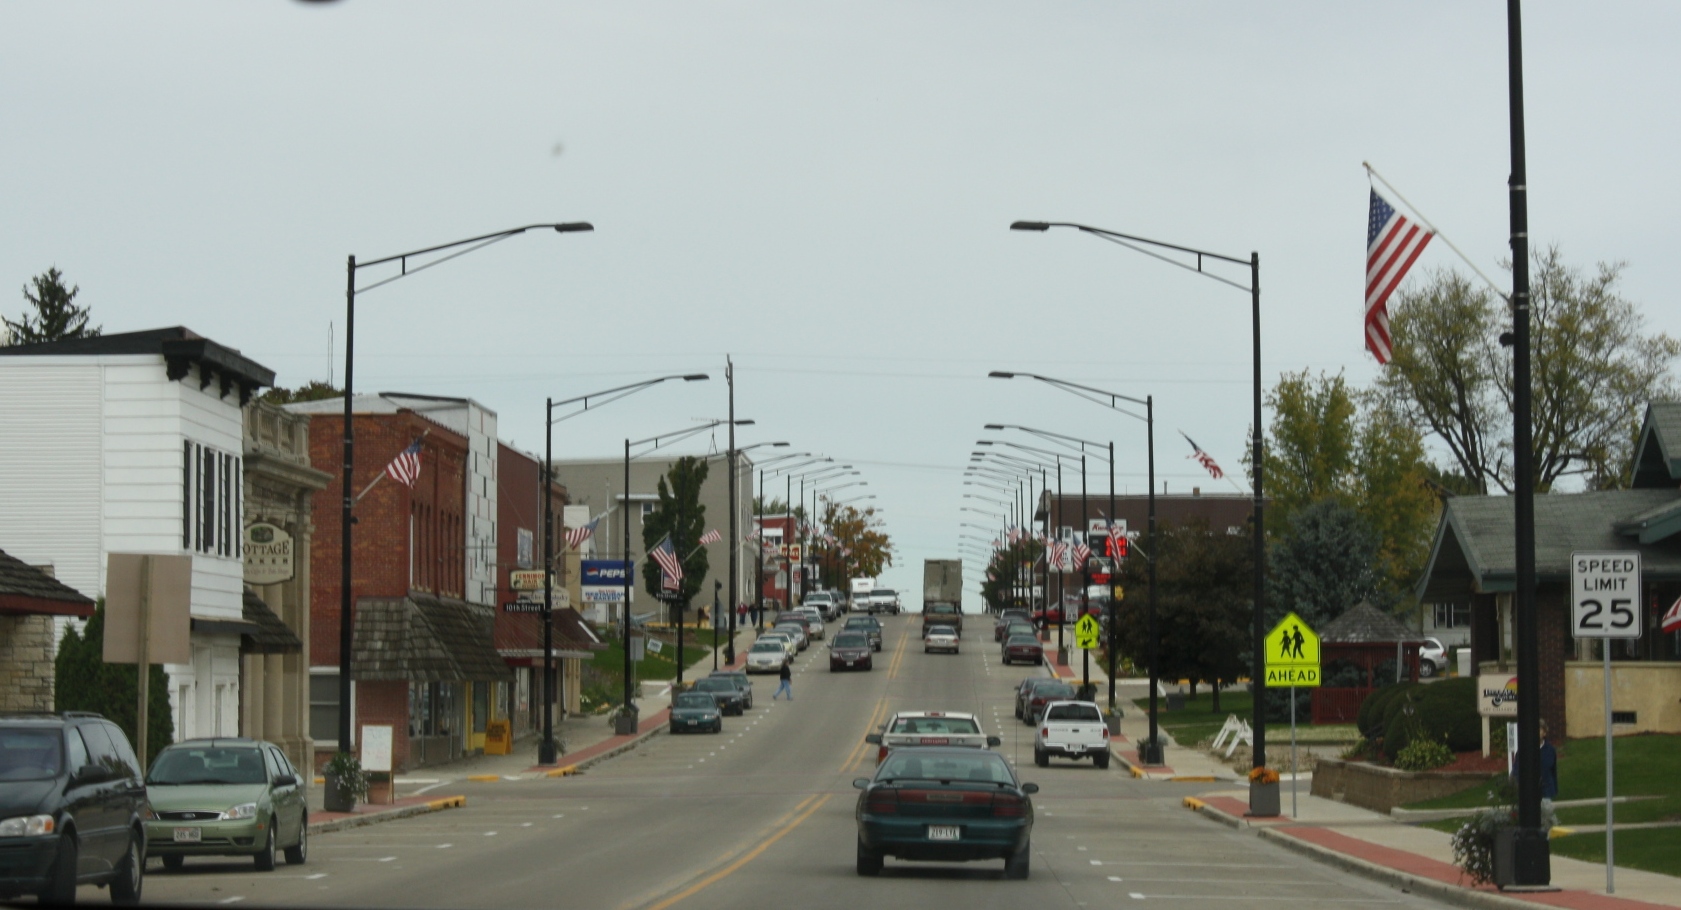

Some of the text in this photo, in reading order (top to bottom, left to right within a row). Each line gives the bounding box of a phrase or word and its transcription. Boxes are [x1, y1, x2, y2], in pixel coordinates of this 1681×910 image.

[243, 540, 290, 555] OTTAGE
[247, 557, 289, 565] AKER
[1577, 559, 1634, 573] SPEED
[600, 568, 626, 578] PEPS
[1584, 578, 1628, 591] LIMIT
[506, 603, 541, 612] 10th Street
[1579, 598, 1634, 629] 25
[1268, 670, 1316, 682] AHEAD
